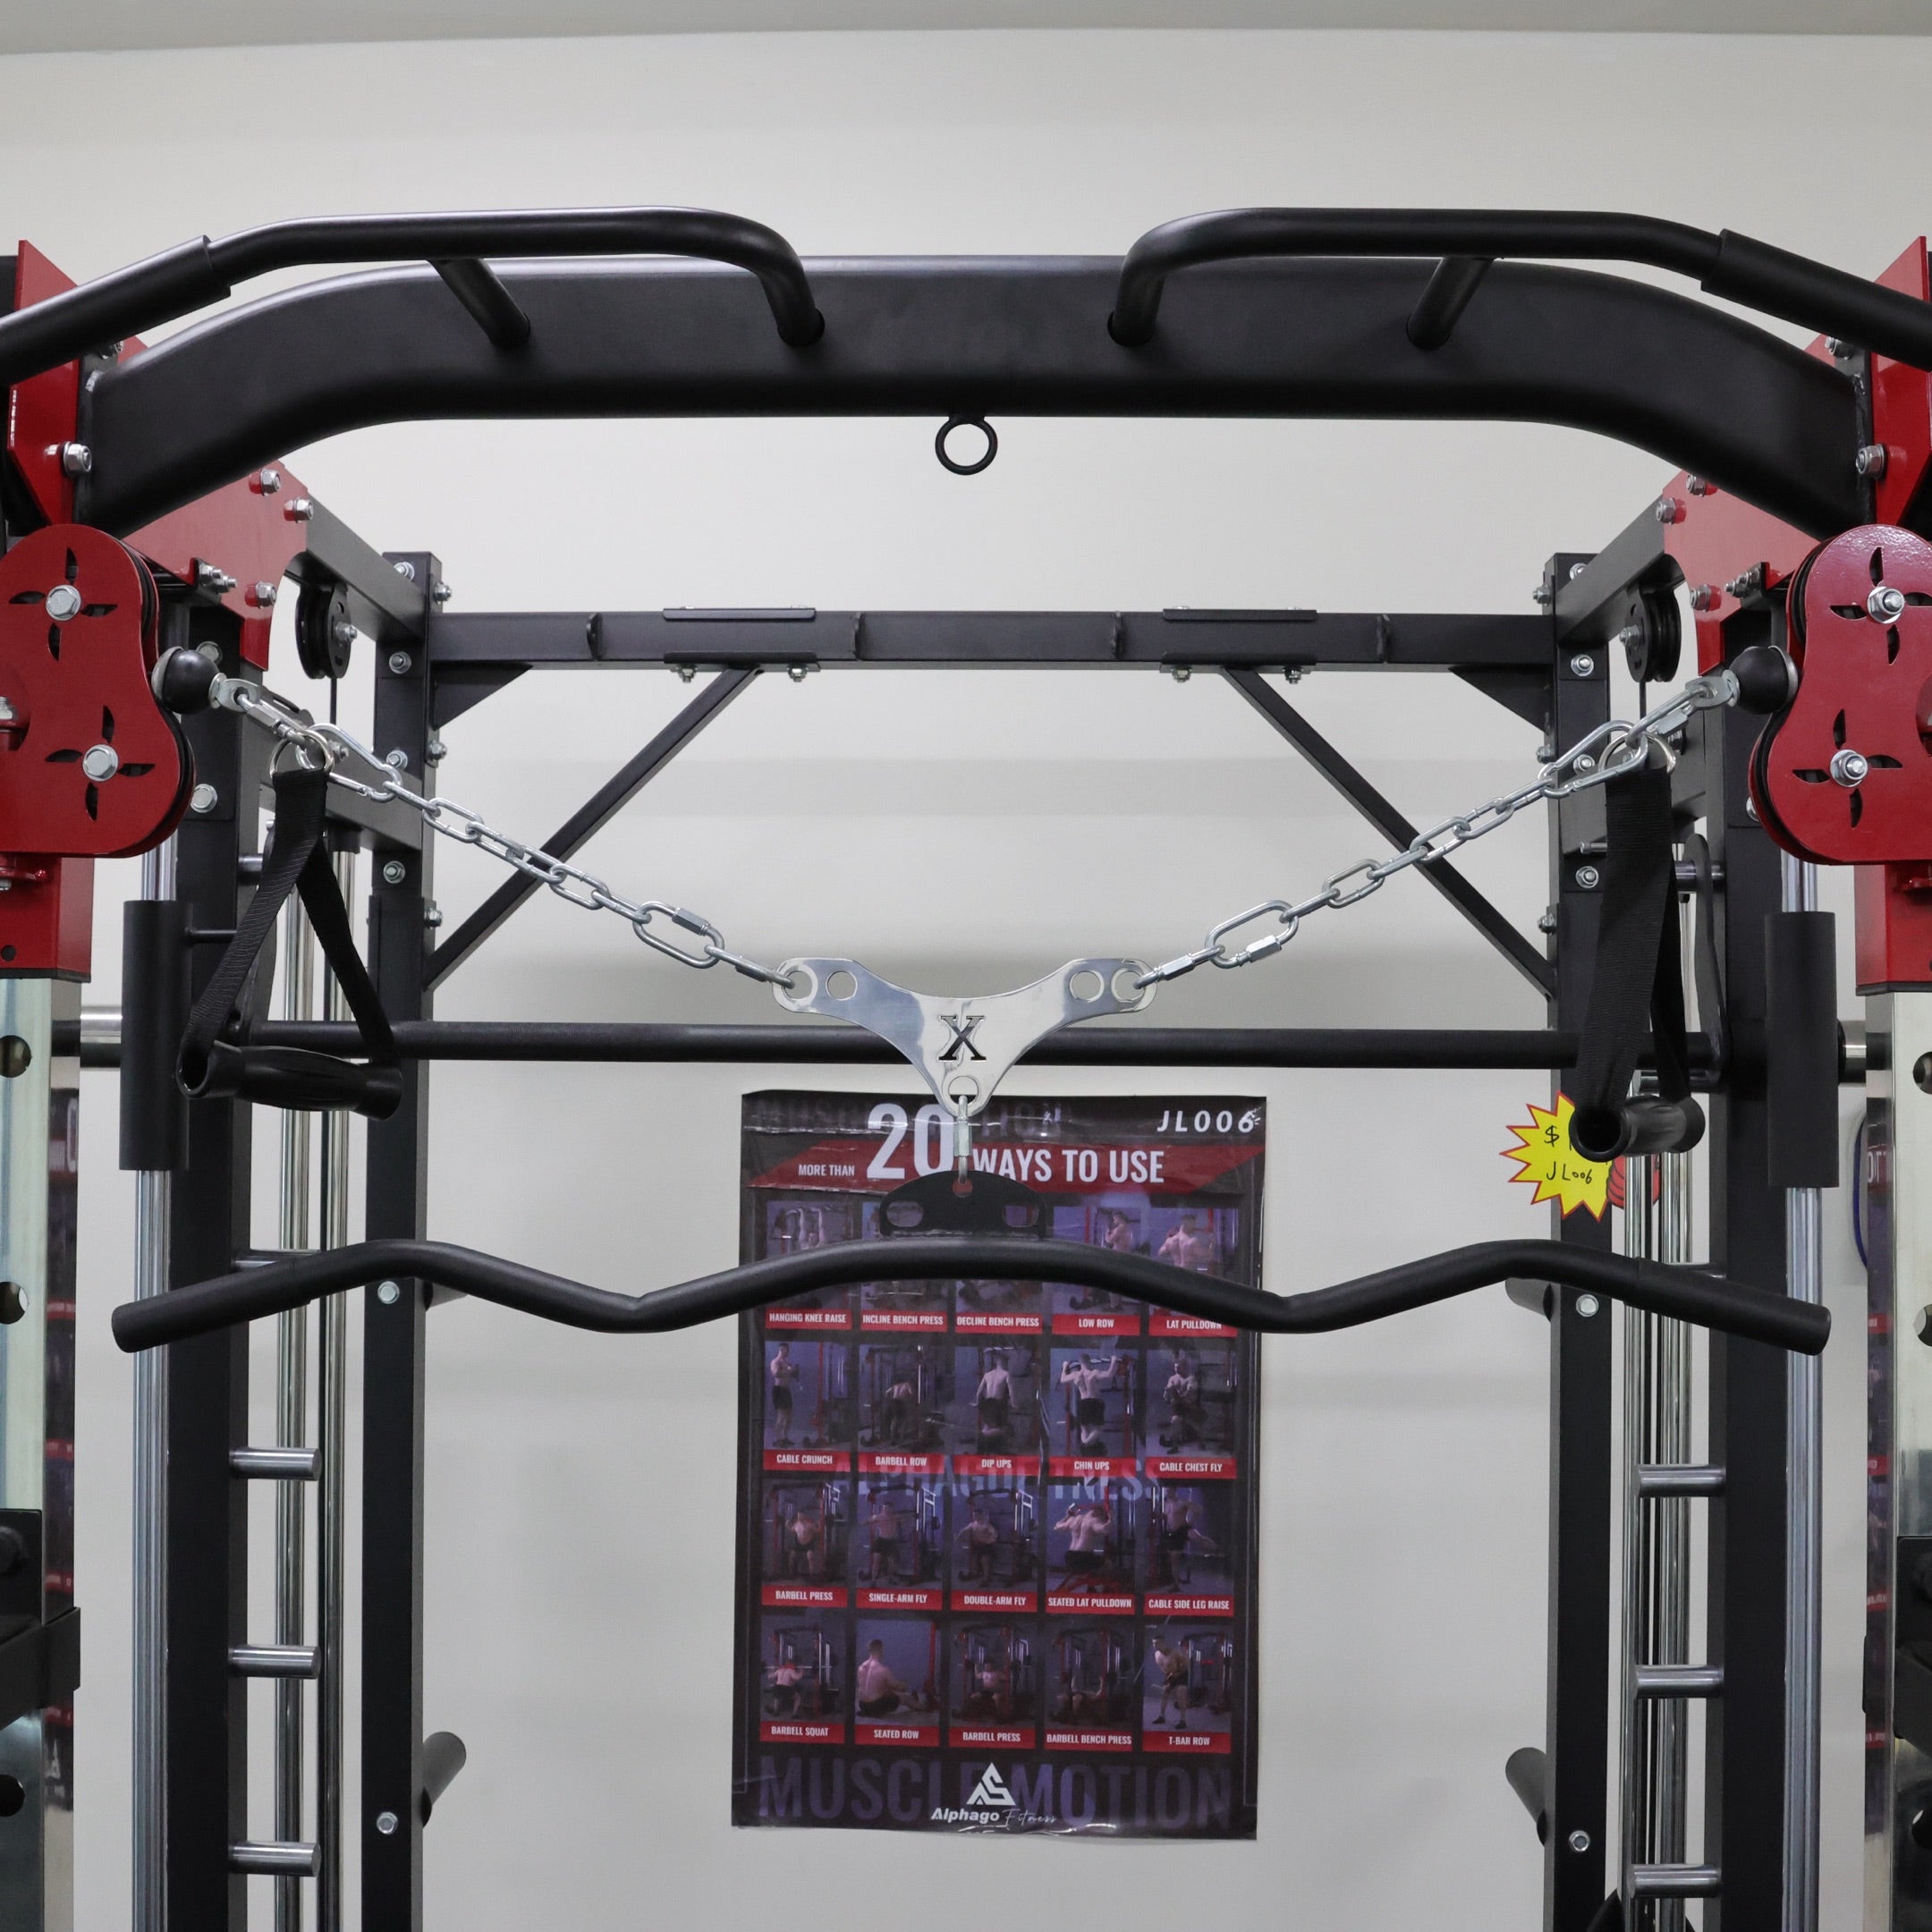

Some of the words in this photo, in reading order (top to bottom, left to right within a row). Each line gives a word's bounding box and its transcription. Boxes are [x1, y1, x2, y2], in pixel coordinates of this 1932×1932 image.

[938, 1015, 987, 1062] X
[1157, 1109, 1255, 1133] JL006
[798, 1164, 828, 1177] MORE
[829, 1164, 856, 1177] THAN
[866, 1102, 956, 1180] 20
[972, 1148, 1052, 1182] WAYS
[1062, 1148, 1098, 1183] TO
[1108, 1149, 1165, 1184] USE
[769, 1313, 802, 1323] HANGING
[804, 1313, 823, 1323] KNEE
[824, 1313, 846, 1324] RAISE
[862, 1314, 890, 1325] INCLINE
[893, 1315, 918, 1325] BENCH
[919, 1315, 943, 1326] PRESS
[956, 1316, 986, 1326] DECLINE
[988, 1317, 1013, 1326] BENCH
[1015, 1317, 1038, 1327] PRESS
[1078, 1318, 1095, 1328] LOW
[1096, 1318, 1114, 1328] ROW
[1165, 1319, 1179, 1329] LAT
[776, 1453, 799, 1464] CABLE
[801, 1454, 832, 1465] CRUNCH
[875, 1456, 908, 1467] BARBELL
[909, 1456, 927, 1467] ROW
[980, 1458, 995, 1469] DIP
[996, 1459, 1012, 1470] UPS
[1073, 1461, 1092, 1470] CHIN
[1094, 1461, 1109, 1471] UPS
[1159, 1462, 1182, 1472] CABLE
[1184, 1462, 1208, 1472] CHEST
[1210, 1462, 1222, 1472] FLY
[775, 1589, 807, 1600] BARBELL
[809, 1591, 833, 1601] PRESS
[869, 1592, 913, 1603] SINGLE-ARM
[915, 1594, 927, 1604] FLY
[963, 1595, 1012, 1606] DOUBLE-ARM
[1013, 1596, 1026, 1606] FLY
[1047, 1597, 1074, 1607] SEATED
[1076, 1597, 1089, 1607] LAT
[1090, 1597, 1131, 1608] PULLDOWN
[1148, 1598, 1172, 1609] CABLE
[1174, 1599, 1190, 1609] SIDE
[1192, 1599, 1206, 1610] LEG
[1208, 1600, 1229, 1610] RAISE
[771, 1725, 802, 1736] BARBELL
[805, 1726, 828, 1737] SQUAT
[873, 1729, 900, 1739] SEATED
[902, 1730, 919, 1740] ROW
[962, 1732, 994, 1741] BARBELL
[996, 1732, 1021, 1742] PRESS
[1046, 1733, 1079, 1744] BARBELL
[1080, 1734, 1106, 1744] BENCH
[1107, 1734, 1131, 1745] PRESS
[1168, 1736, 1191, 1746] T-BAR
[1192, 1736, 1209, 1746] ROW
[931, 1807, 1000, 1824] Alphago
